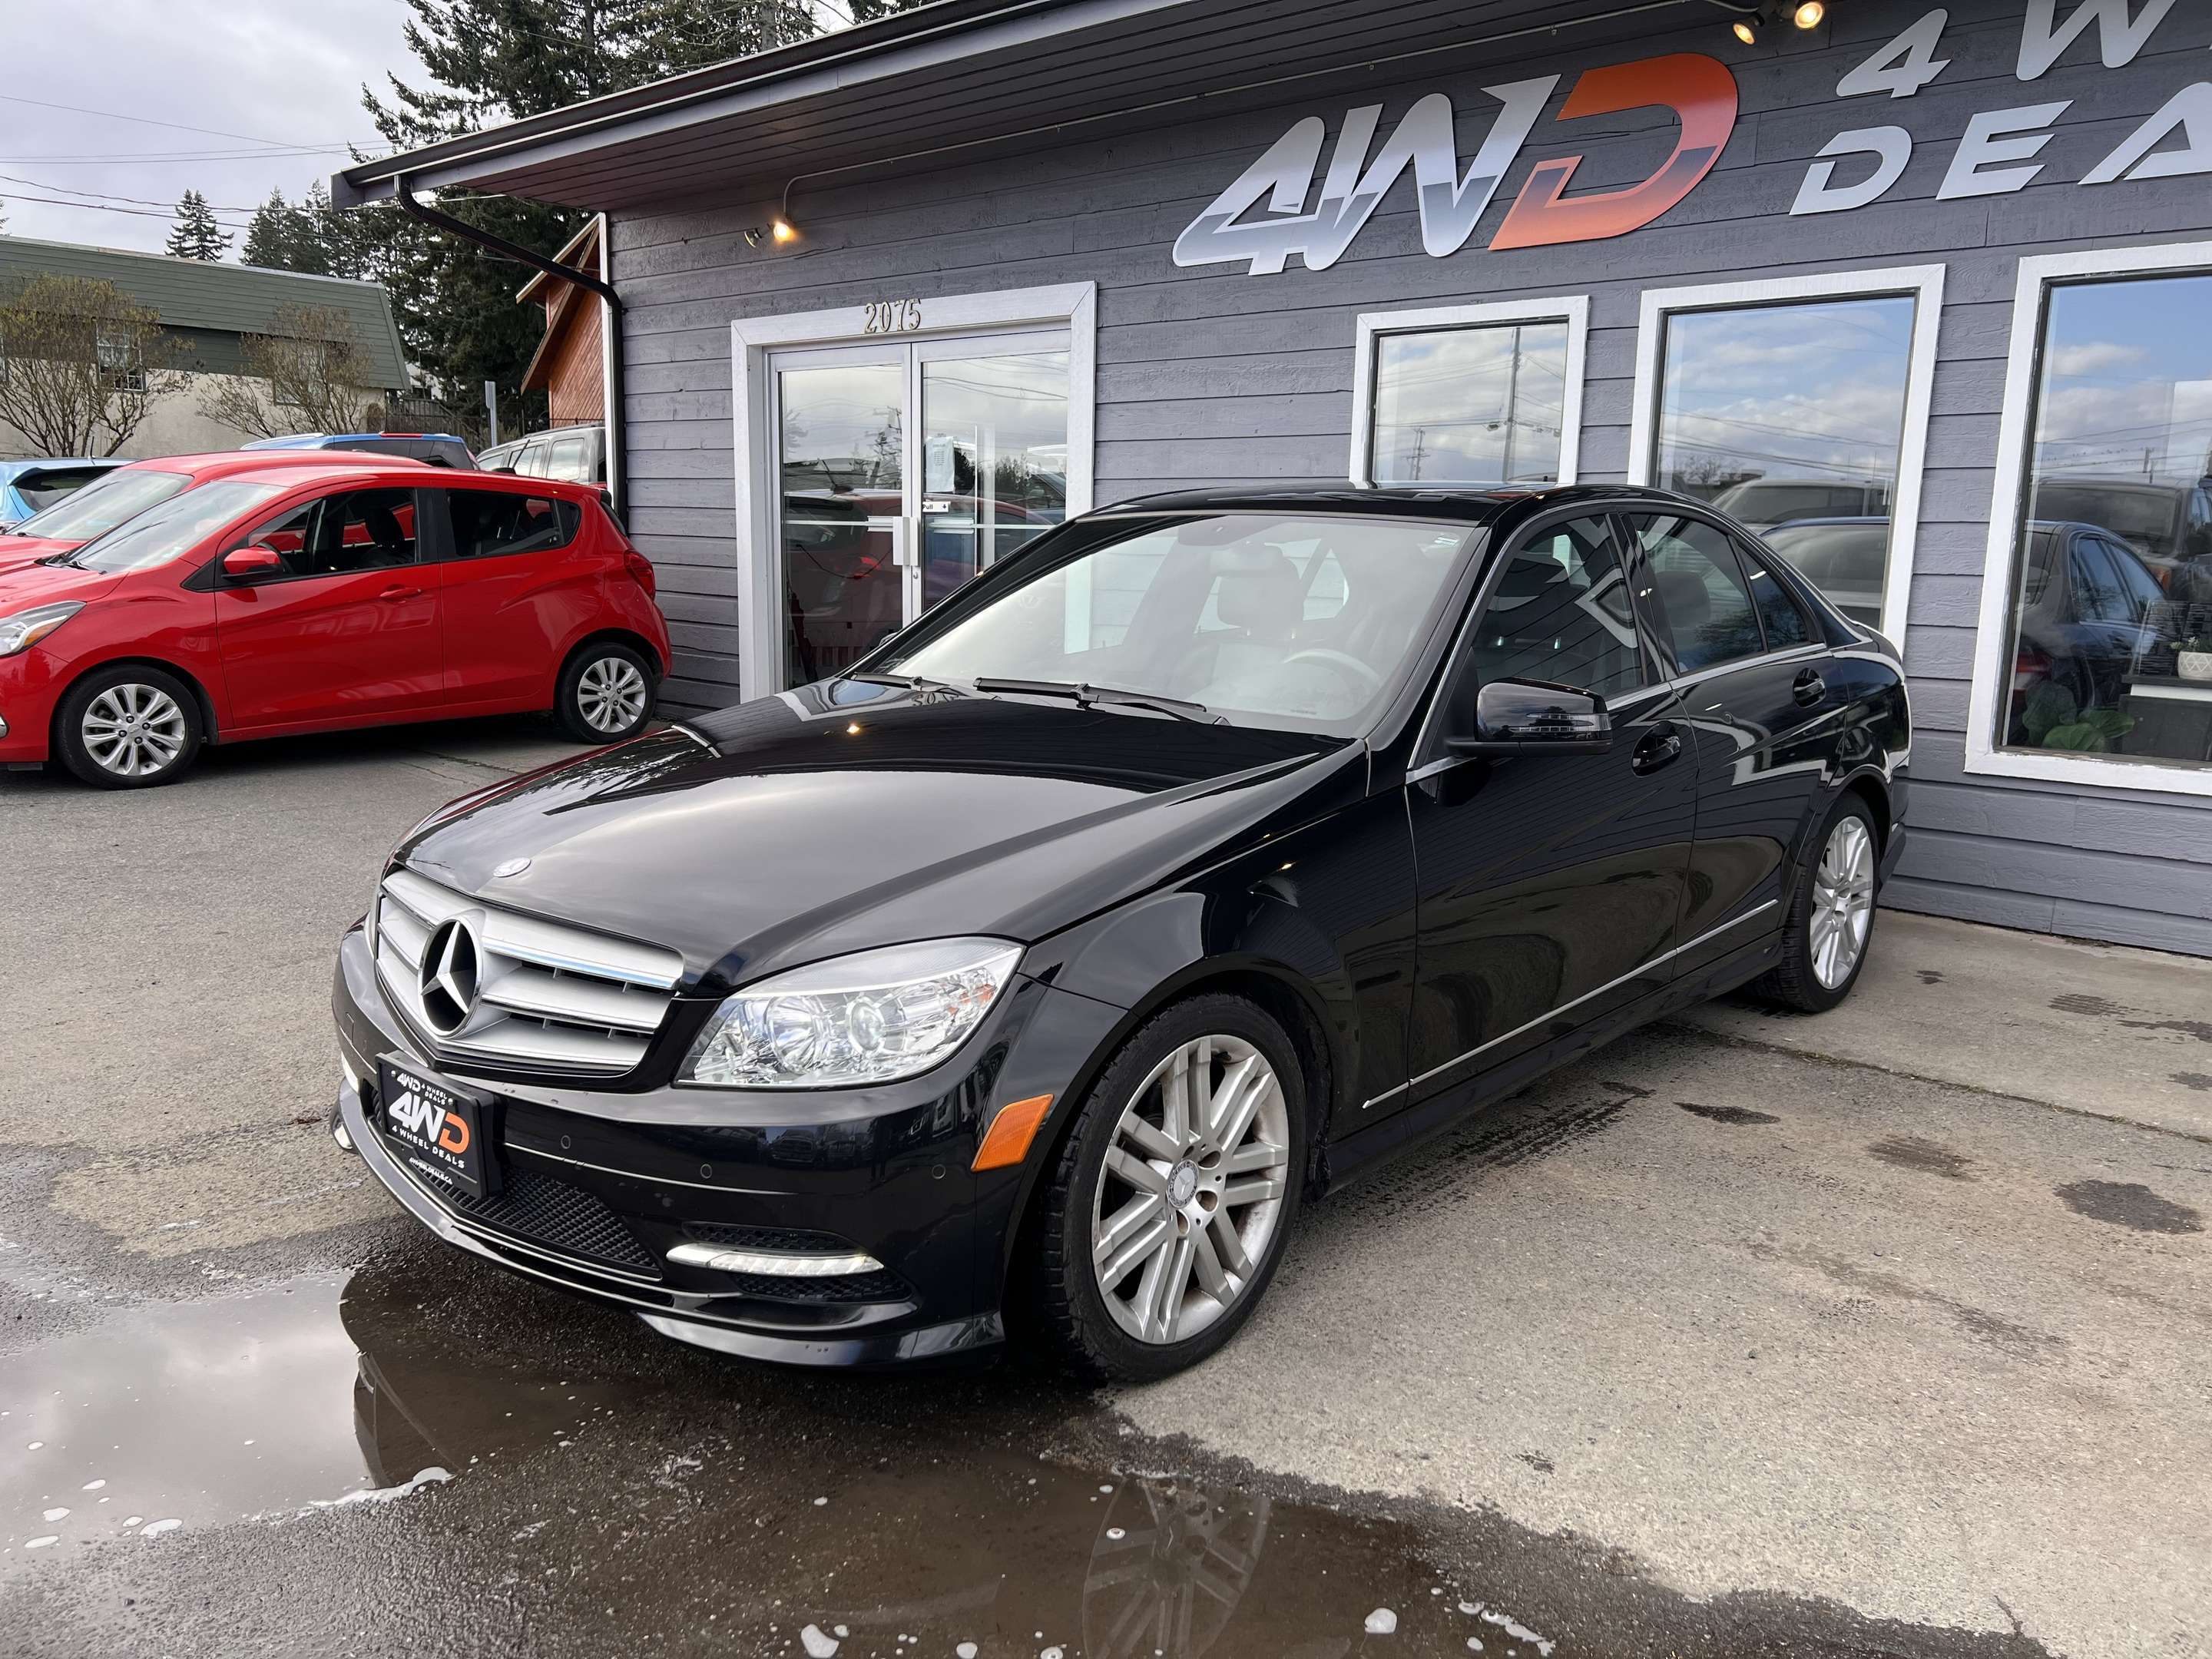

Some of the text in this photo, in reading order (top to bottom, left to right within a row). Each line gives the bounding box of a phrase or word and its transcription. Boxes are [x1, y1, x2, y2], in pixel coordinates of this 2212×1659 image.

[1836, 8, 1951, 98] 4
[1172, 52, 1739, 276] 4WD
[864, 298, 921, 333] 2075
[424, 1091, 445, 1105] DEALS
[426, 1084, 447, 1100] WHEEL
[389, 1091, 469, 1154] 4WD
[392, 1124, 465, 1169] 4 WHEEL DEALS
